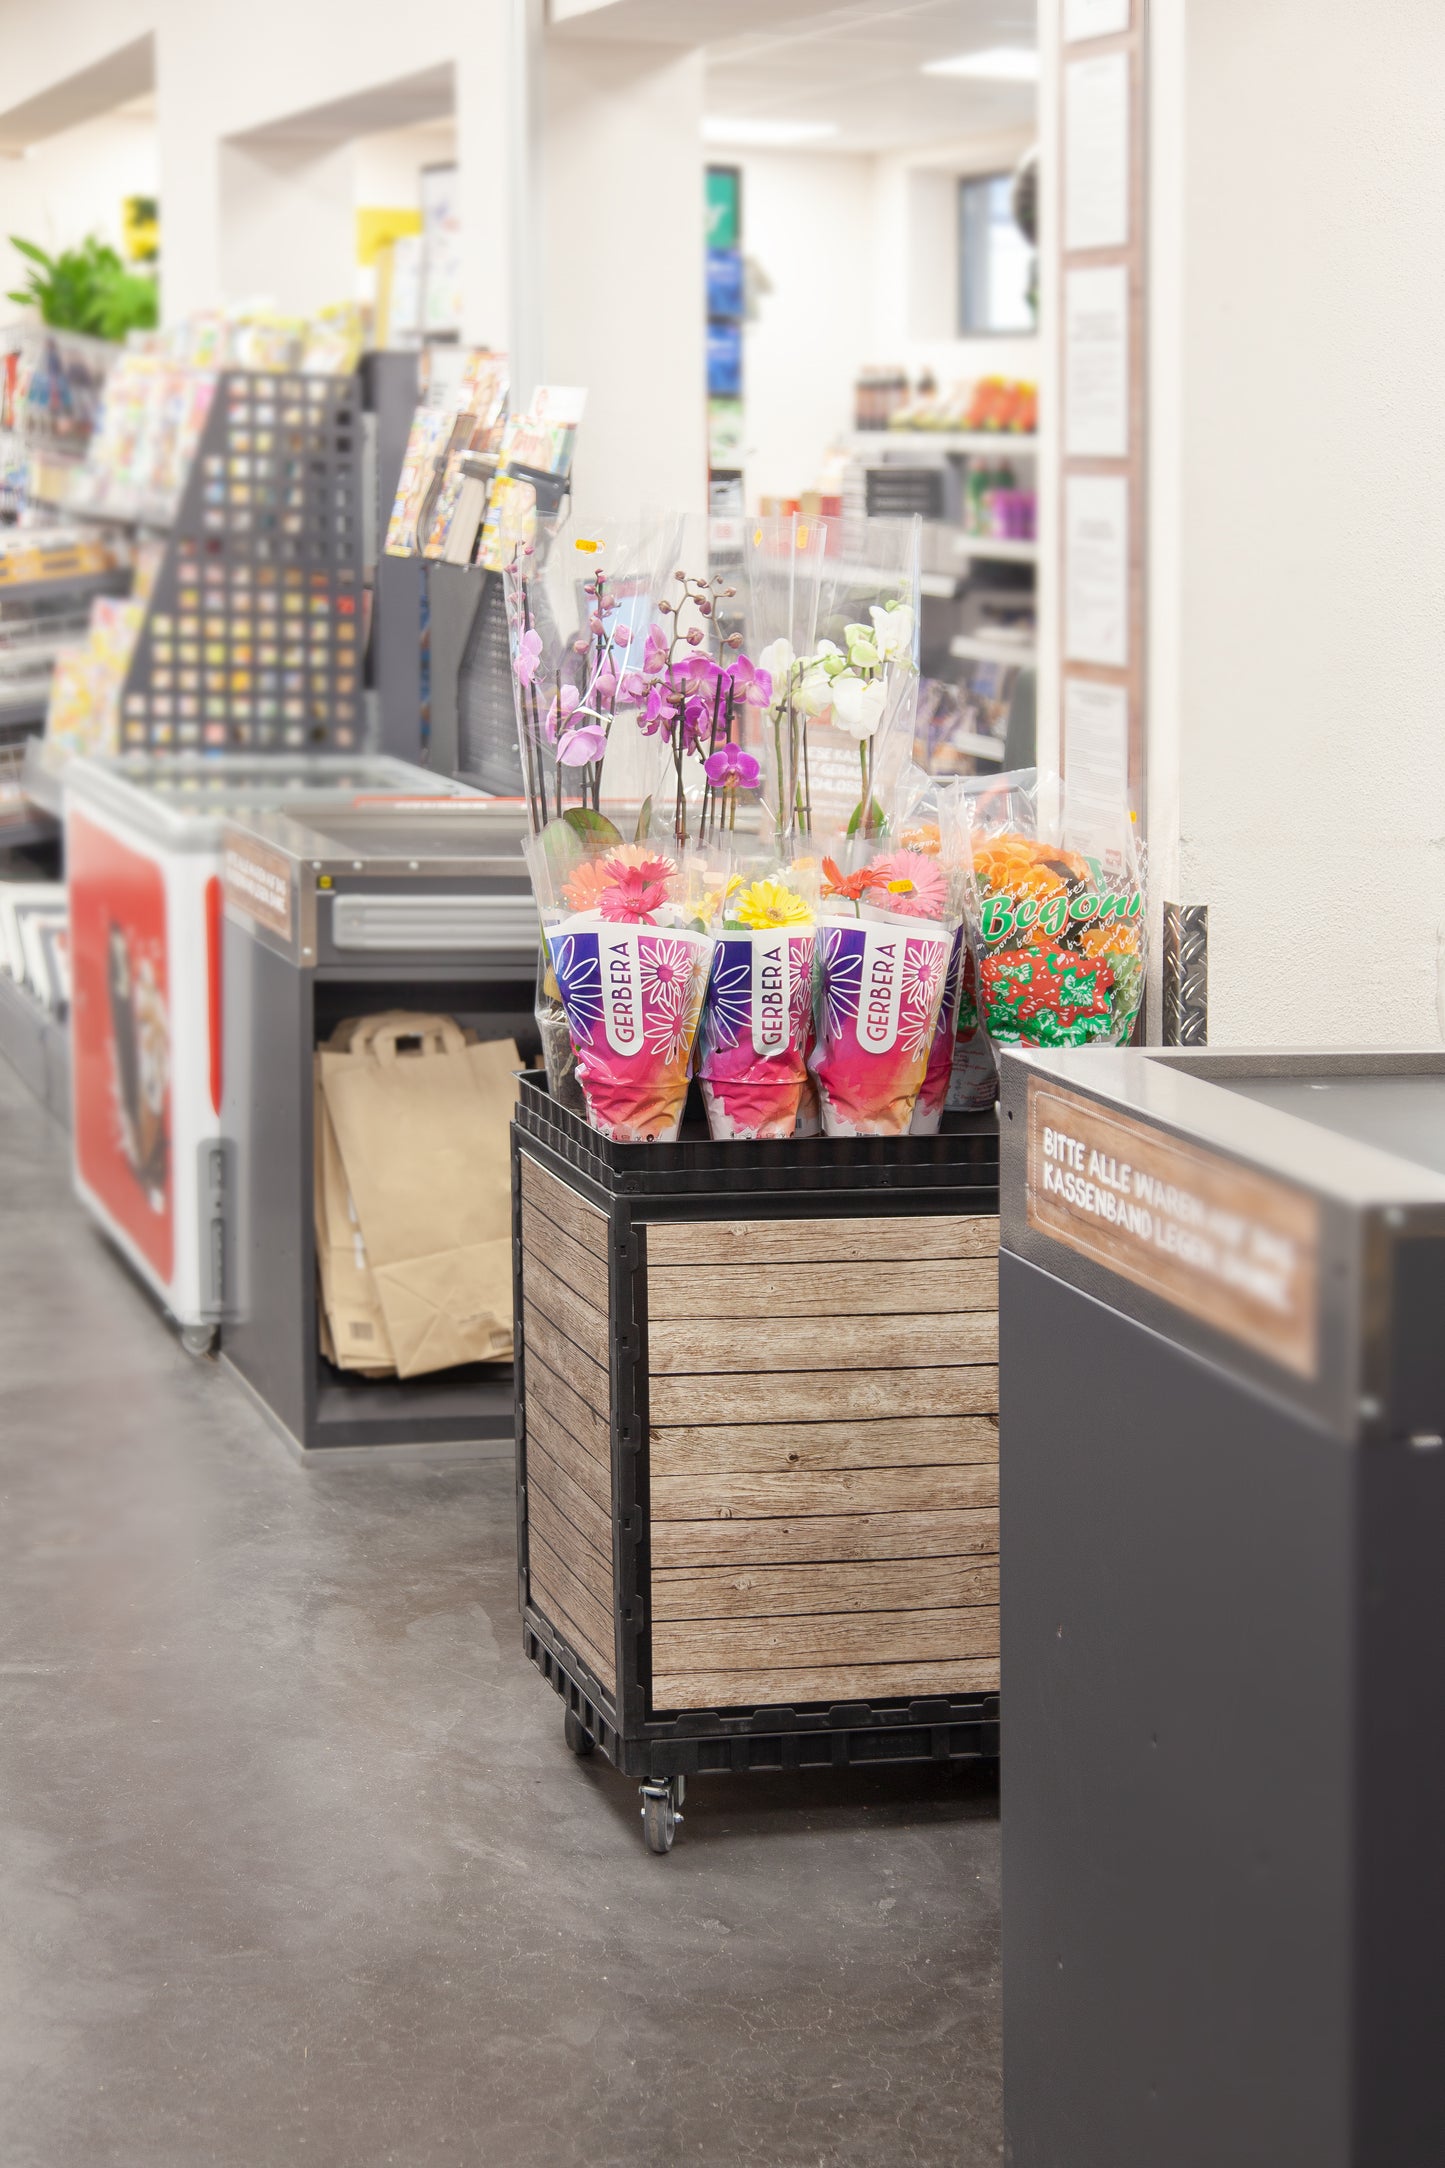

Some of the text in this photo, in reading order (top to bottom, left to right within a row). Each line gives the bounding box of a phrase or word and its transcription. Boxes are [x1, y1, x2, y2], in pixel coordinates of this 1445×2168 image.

[980, 891, 1146, 944] Begoni
[608, 942, 635, 1043] GERBERA
[761, 946, 784, 1045] GERBERA
[866, 943, 897, 1041] GERBERA
[1043, 1126, 1086, 1172] BITTE
[1088, 1149, 1132, 1194] ALLE
[1133, 1171, 1205, 1227] WAREN
[1043, 1161, 1153, 1241] KASSENBAND
